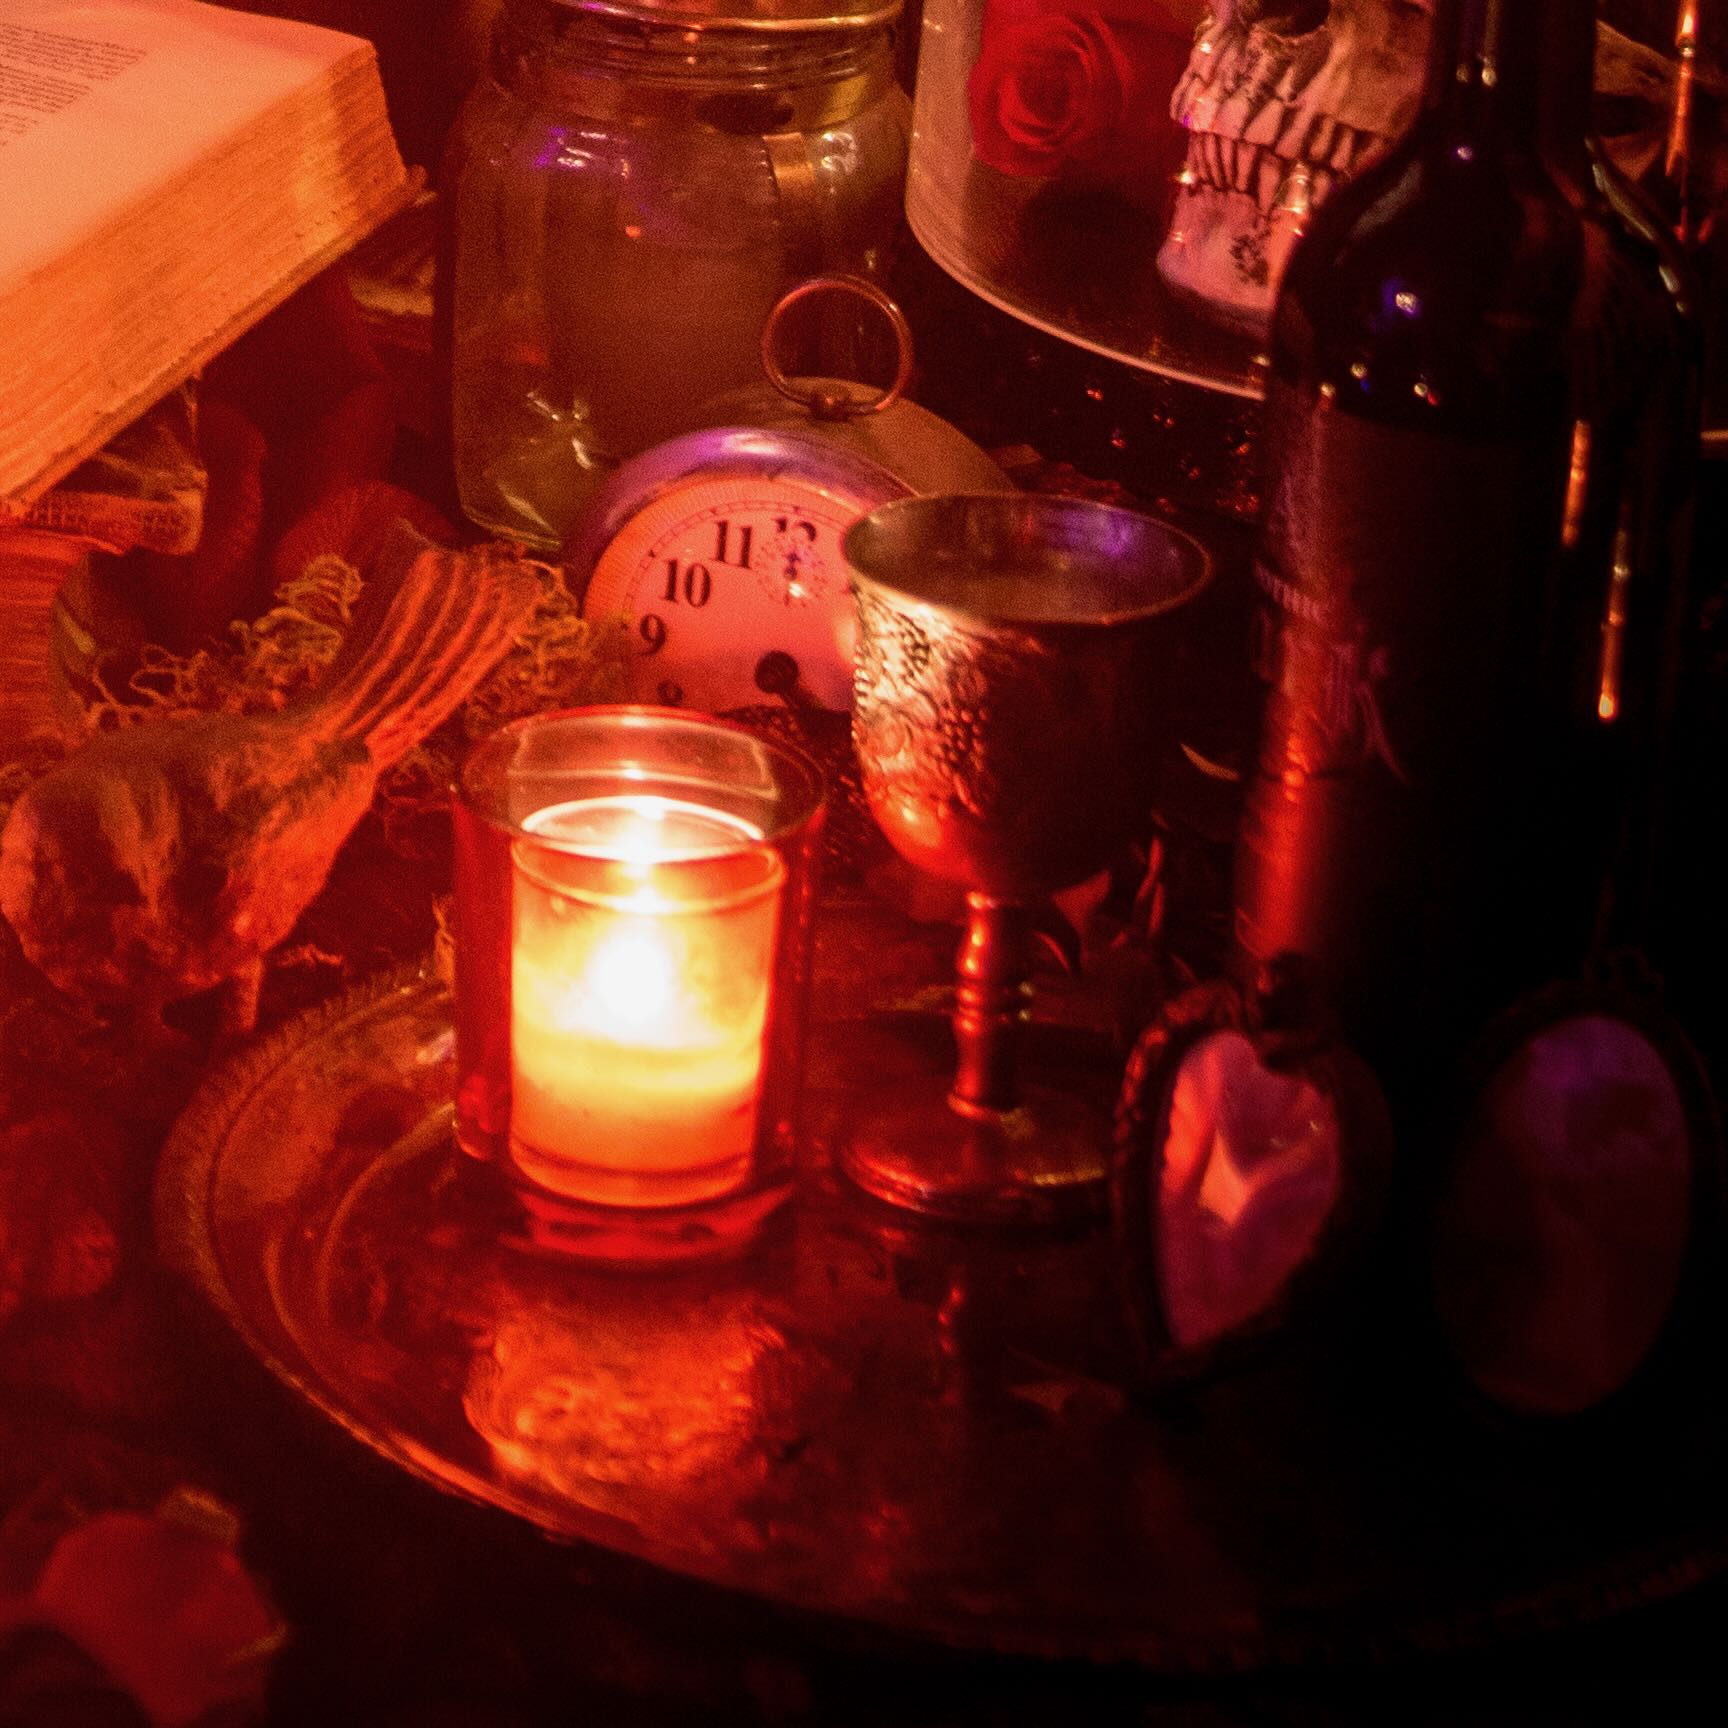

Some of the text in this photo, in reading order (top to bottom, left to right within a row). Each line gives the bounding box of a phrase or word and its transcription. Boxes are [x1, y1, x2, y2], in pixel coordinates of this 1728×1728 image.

[715, 519, 753, 569] 11
[662, 559, 711, 608] 10
[639, 613, 668, 656] 9
